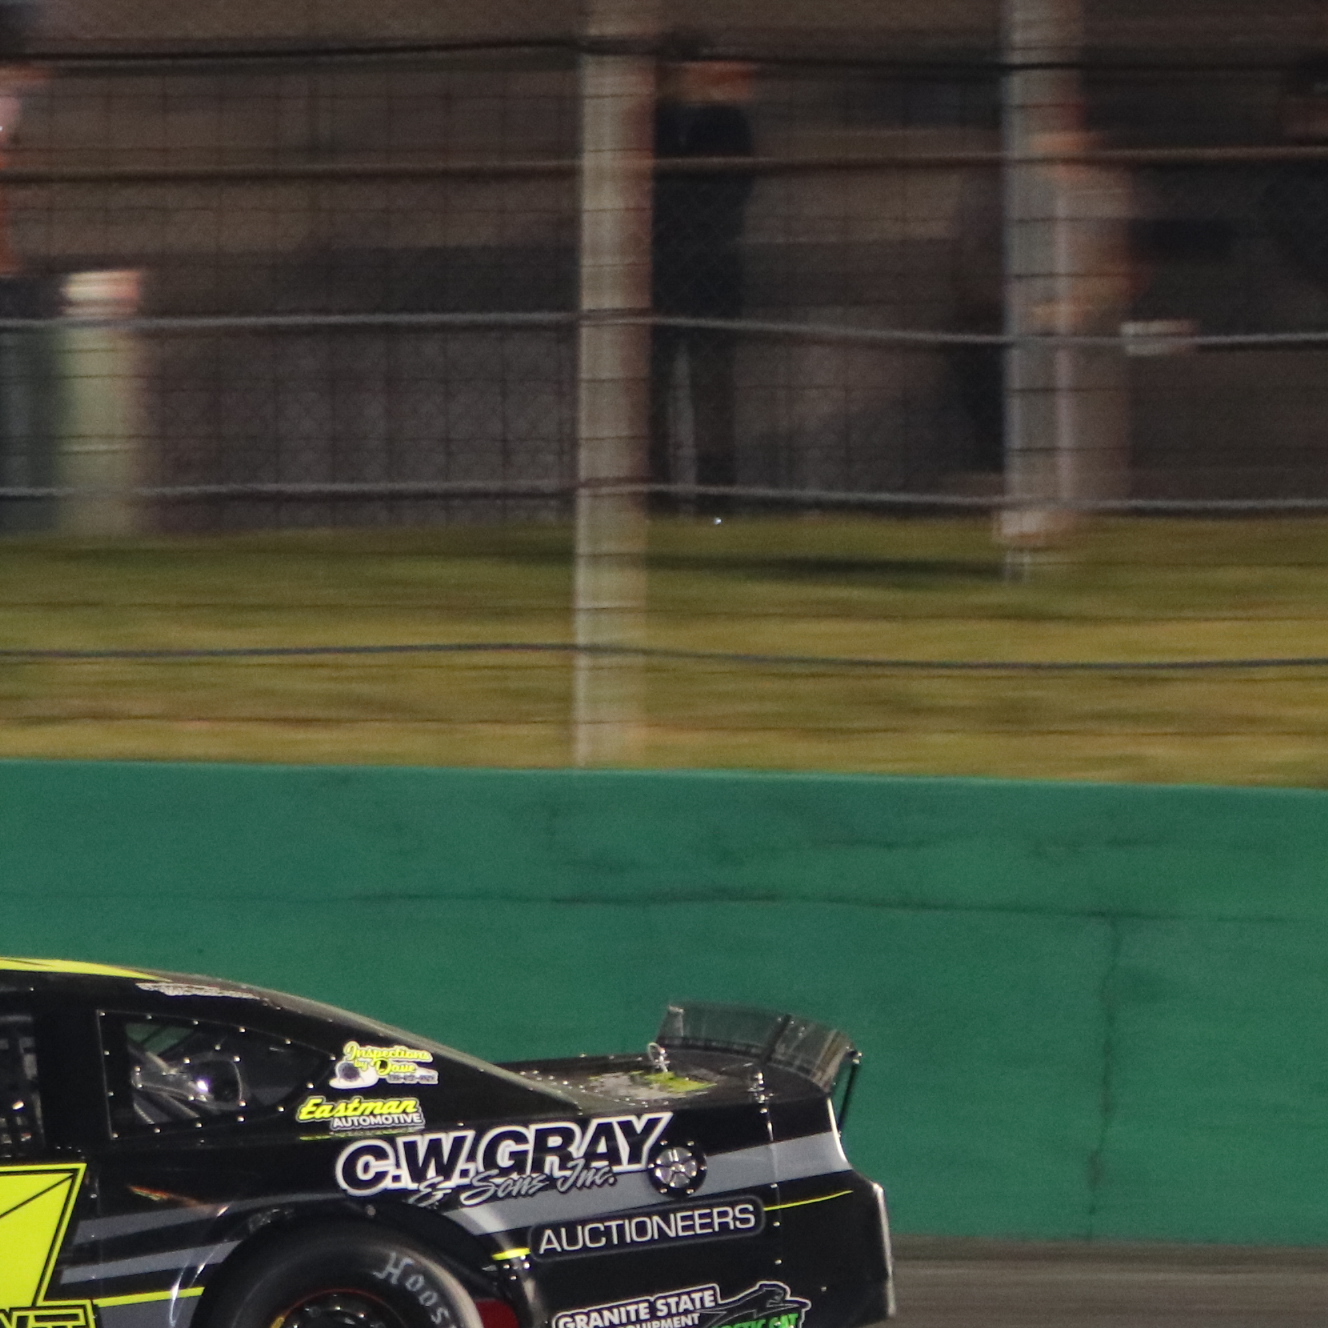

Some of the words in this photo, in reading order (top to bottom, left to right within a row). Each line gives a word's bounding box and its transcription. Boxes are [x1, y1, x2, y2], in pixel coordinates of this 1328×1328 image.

[346, 1042, 432, 1061] Inspections
[372, 1058, 417, 1077] Dave
[298, 1097, 418, 1121] Eastman
[332, 1113, 423, 1128] AUTOMOTIVE
[335, 1112, 673, 1197] C.W.GRAY
[461, 1169, 551, 1206] Sons
[556, 1159, 616, 1192] Inc.
[538, 1203, 756, 1255] AUCTIONEERS
[655, 1290, 716, 1316] STATE
